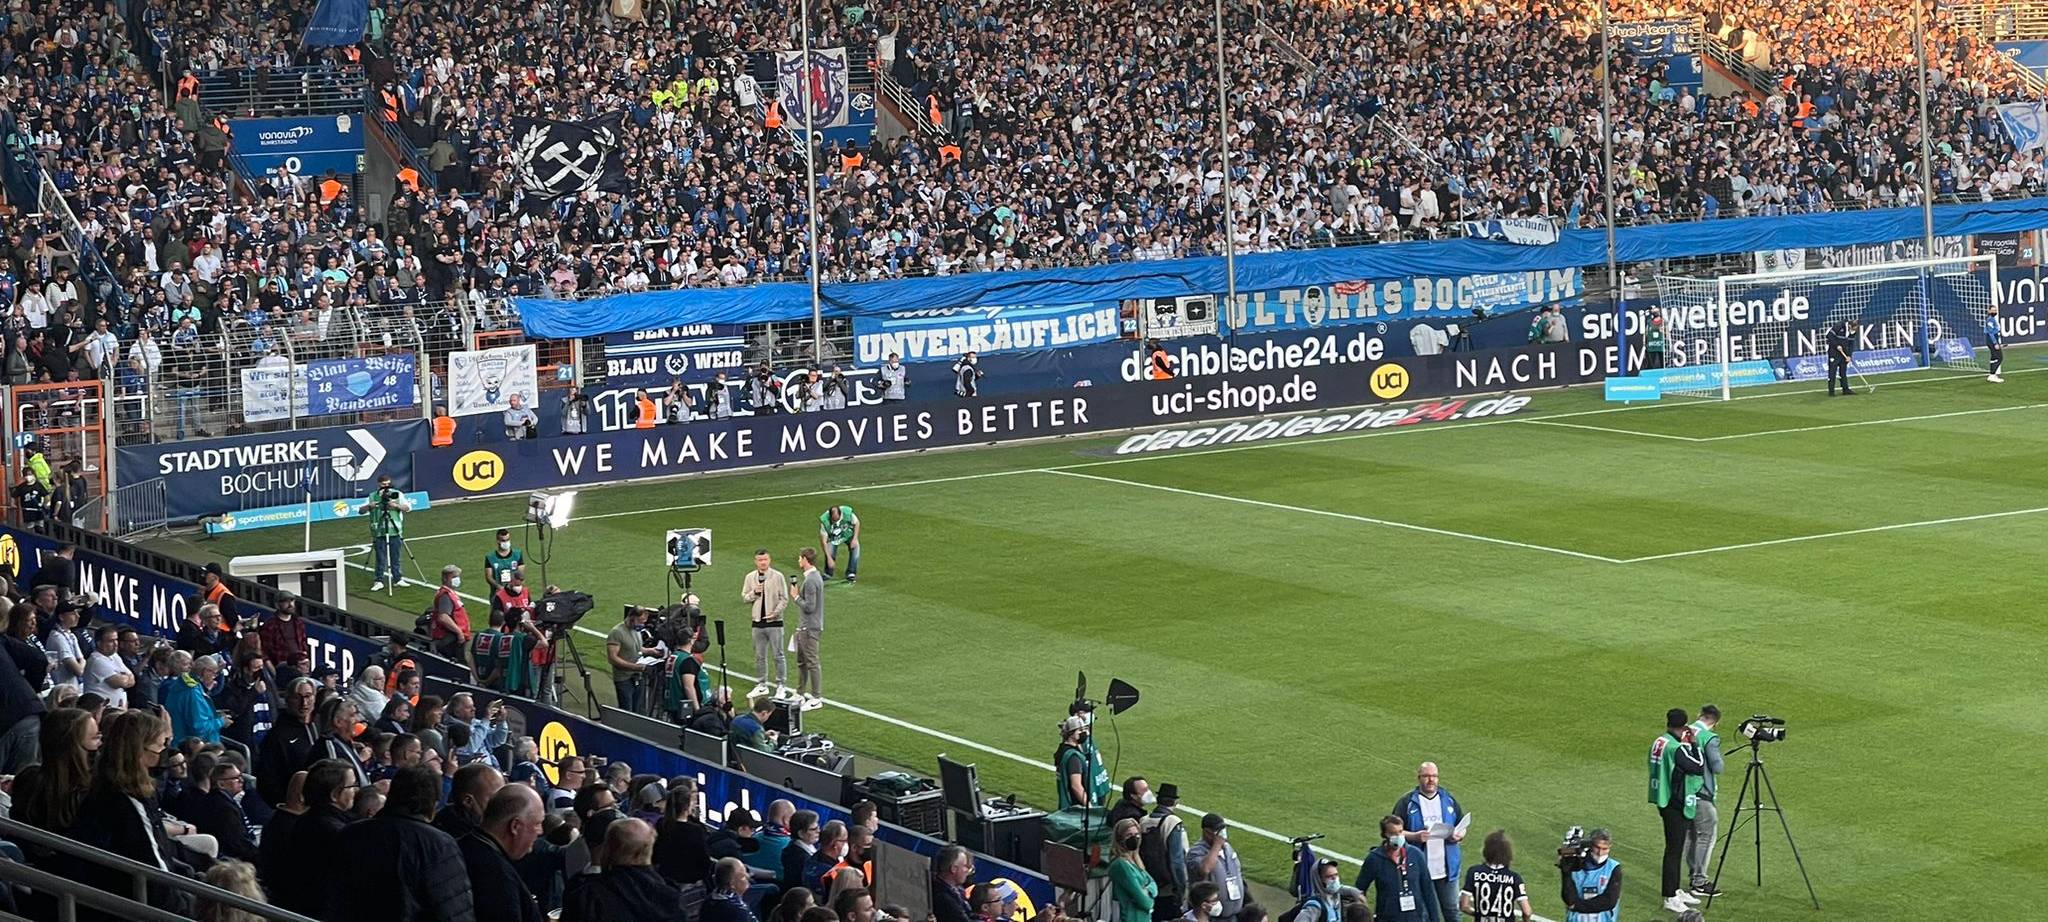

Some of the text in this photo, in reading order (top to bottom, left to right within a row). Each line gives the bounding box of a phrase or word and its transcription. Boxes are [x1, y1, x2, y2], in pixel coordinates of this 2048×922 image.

[2023, 248, 2033, 258] 23
[1413, 267, 1576, 312] BOCUM
[858, 308, 1118, 363] UNVERKÄUFLICH
[1123, 319, 1138, 331] 22
[606, 356, 658, 378] BLAU
[1377, 372, 1402, 390] UCI
[1455, 351, 1556, 388] NACH
[1579, 343, 1646, 376] DEM
[1673, 334, 1763, 368] SPIEL
[1860, 318, 1943, 351] KINO
[1856, 357, 1895, 368] hinterm
[1894, 355, 1911, 365] Tor
[308, 363, 347, 381] Blau
[318, 375, 397, 393] 18 48
[559, 367, 573, 379] 21
[1151, 374, 1317, 416] uci-shop.de
[462, 398, 1089, 482] UCI WE MAKE MOVIES BETTER
[1116, 396, 1532, 455] dachbleche24.de
[159, 439, 319, 475] STADTWERKE
[220, 465, 319, 496] BOCHUM
[237, 510, 308, 526] sportwetten.de
[80, 559, 140, 619] MAKE
[1473, 871, 1515, 885] BOCHUM
[1473, 881, 1514, 918] 1848
